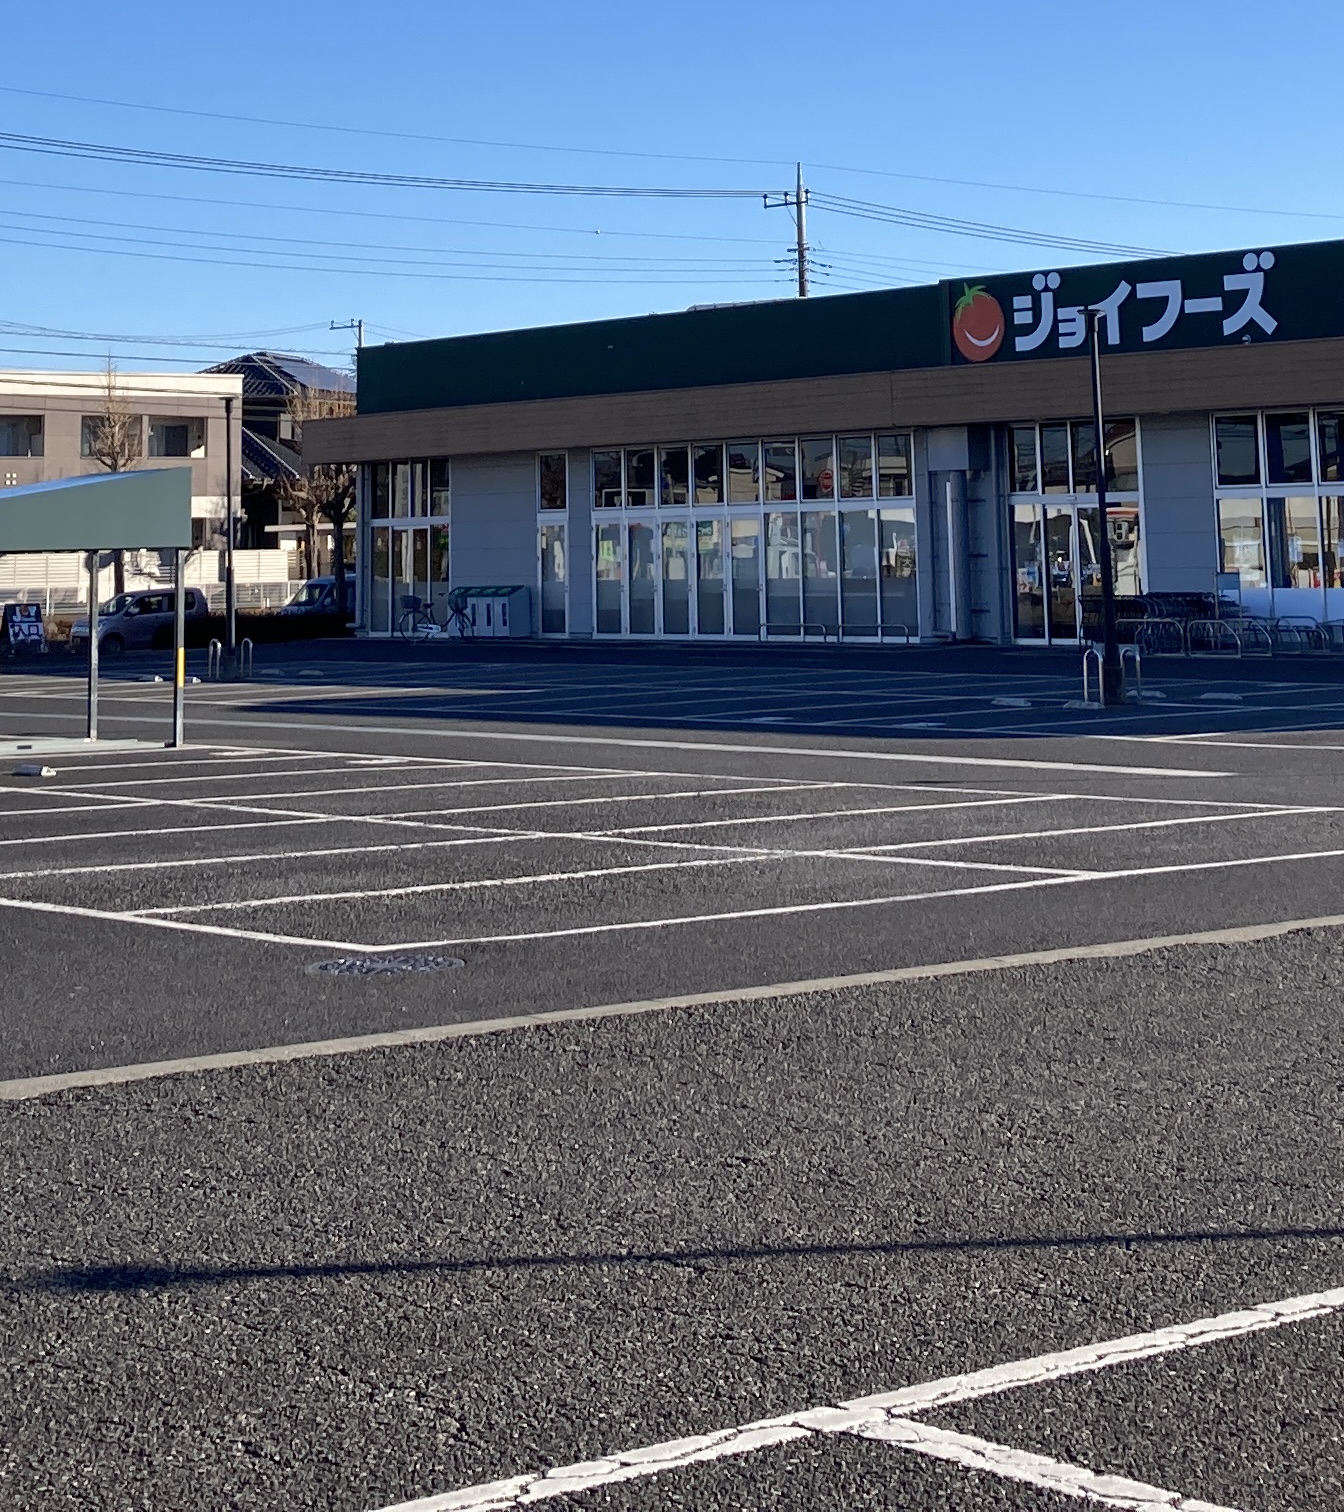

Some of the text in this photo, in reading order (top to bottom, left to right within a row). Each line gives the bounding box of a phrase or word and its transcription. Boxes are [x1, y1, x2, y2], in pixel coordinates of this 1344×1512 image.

[1012, 250, 1279, 352] ジョイフーズ
